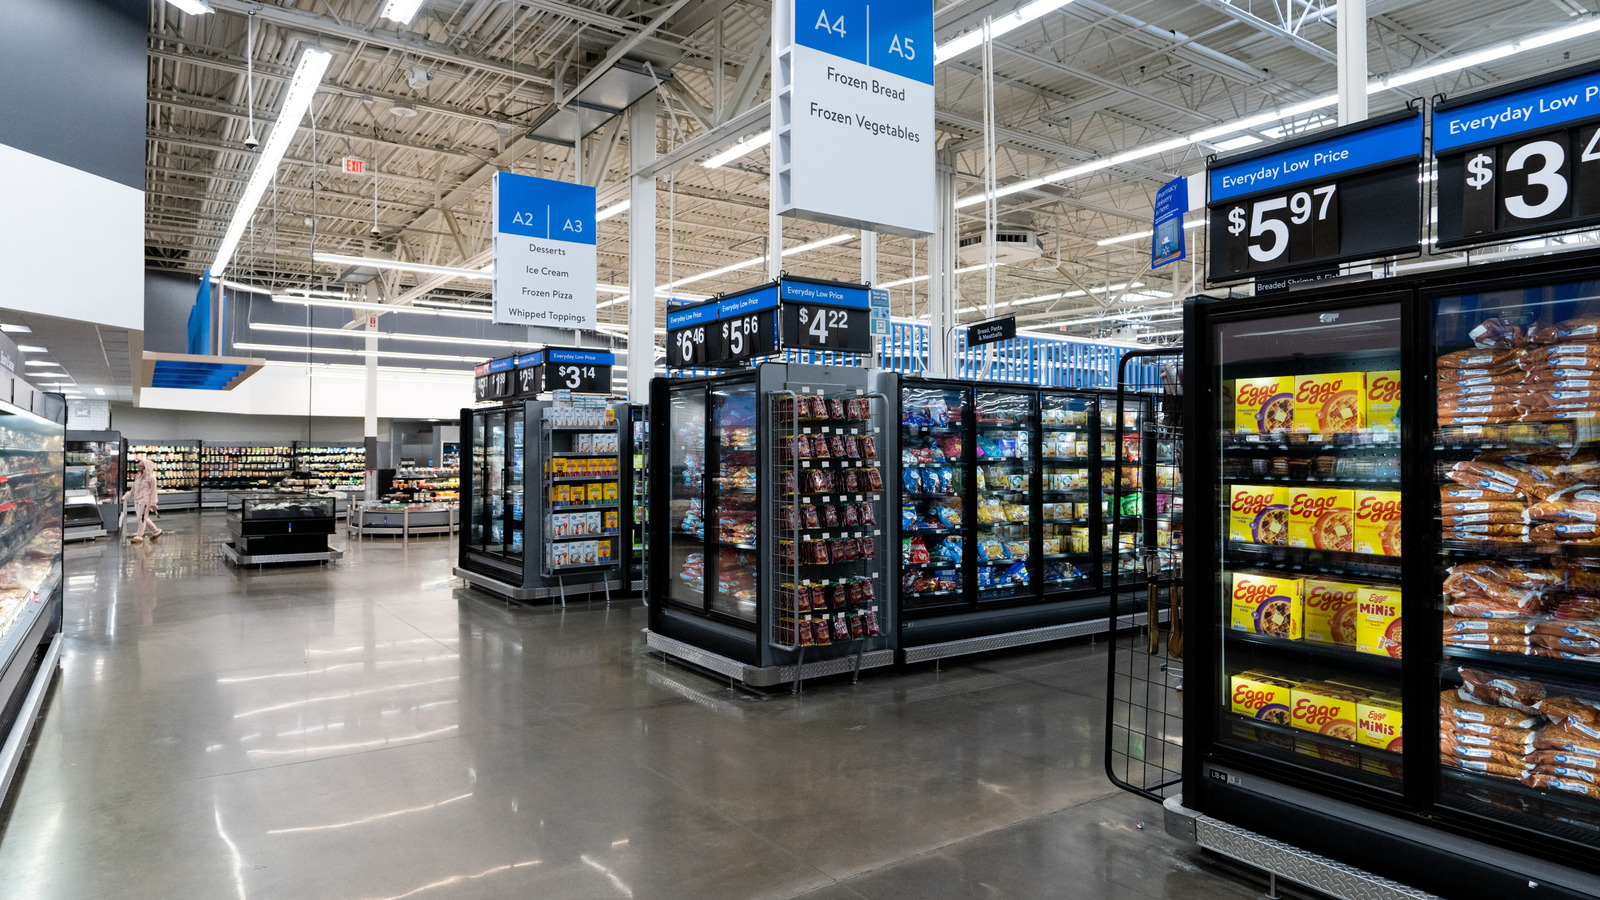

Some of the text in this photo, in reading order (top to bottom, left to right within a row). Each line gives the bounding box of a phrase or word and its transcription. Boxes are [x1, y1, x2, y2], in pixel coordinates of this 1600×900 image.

[814, 8, 847, 38] A4
[888, 33, 916, 61] A5
[827, 66, 906, 101] Frozen Bread
[1450, 86, 1600, 135] Everyday Low P
[810, 102, 920, 143] Frozen Vegetables
[346, 159, 363, 173] EXIT
[1222, 149, 1349, 188] Everyday Low Price
[512, 211, 534, 227] A2
[562, 218, 583, 233] A3
[529, 243, 566, 256] Desserts
[526, 265, 569, 278] Ice Cream
[522, 286, 573, 300] Frozen Pizza
[787, 286, 844, 300] Everyday Low Price
[1257, 280, 1286, 291] Breaded
[722, 297, 758, 314] Everyday Low Price
[508, 307, 586, 323] Whipped Toppings
[670, 311, 702, 324] Everyday Low Price
[977, 327, 990, 335] Bread,
[983, 332, 1003, 340] Meatballs
[553, 352, 575, 361] Everyday
[1237, 383, 1279, 407] Eggo
[1296, 379, 1343, 405] Eggo
[1231, 490, 1275, 515] Eggo
[1290, 493, 1337, 519] Eggo
[1233, 579, 1278, 604] Eggo
[1307, 586, 1356, 612] Eggo
[1368, 593, 1388, 604] Eggo
[1233, 684, 1275, 710] Eggo
[1293, 698, 1340, 726] Eggo
[1367, 710, 1386, 721] Eggo
